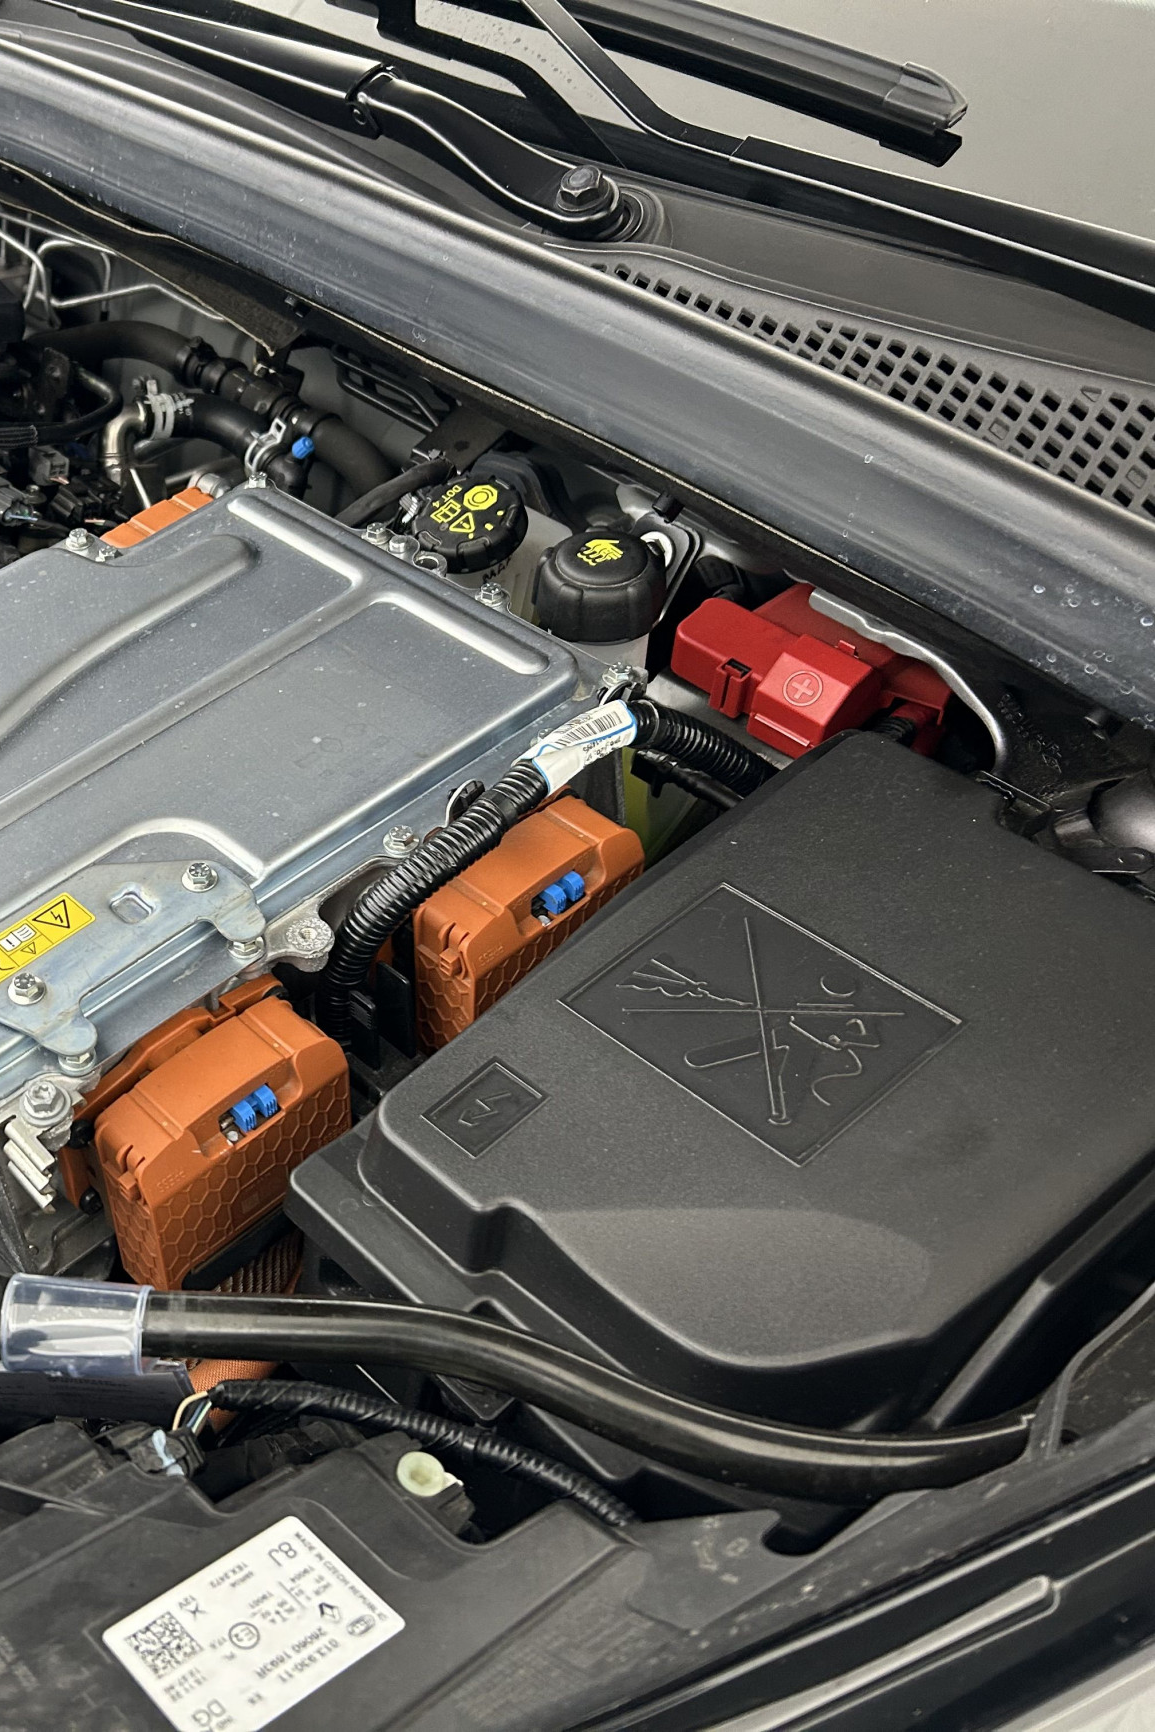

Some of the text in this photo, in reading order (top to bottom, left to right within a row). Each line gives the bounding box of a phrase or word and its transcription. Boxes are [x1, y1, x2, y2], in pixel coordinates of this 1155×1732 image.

[440, 484, 463, 503] DOT
[267, 1541, 298, 1567] 8J
[177, 1594, 195, 1609] 12V
[191, 1698, 227, 1727] DG
